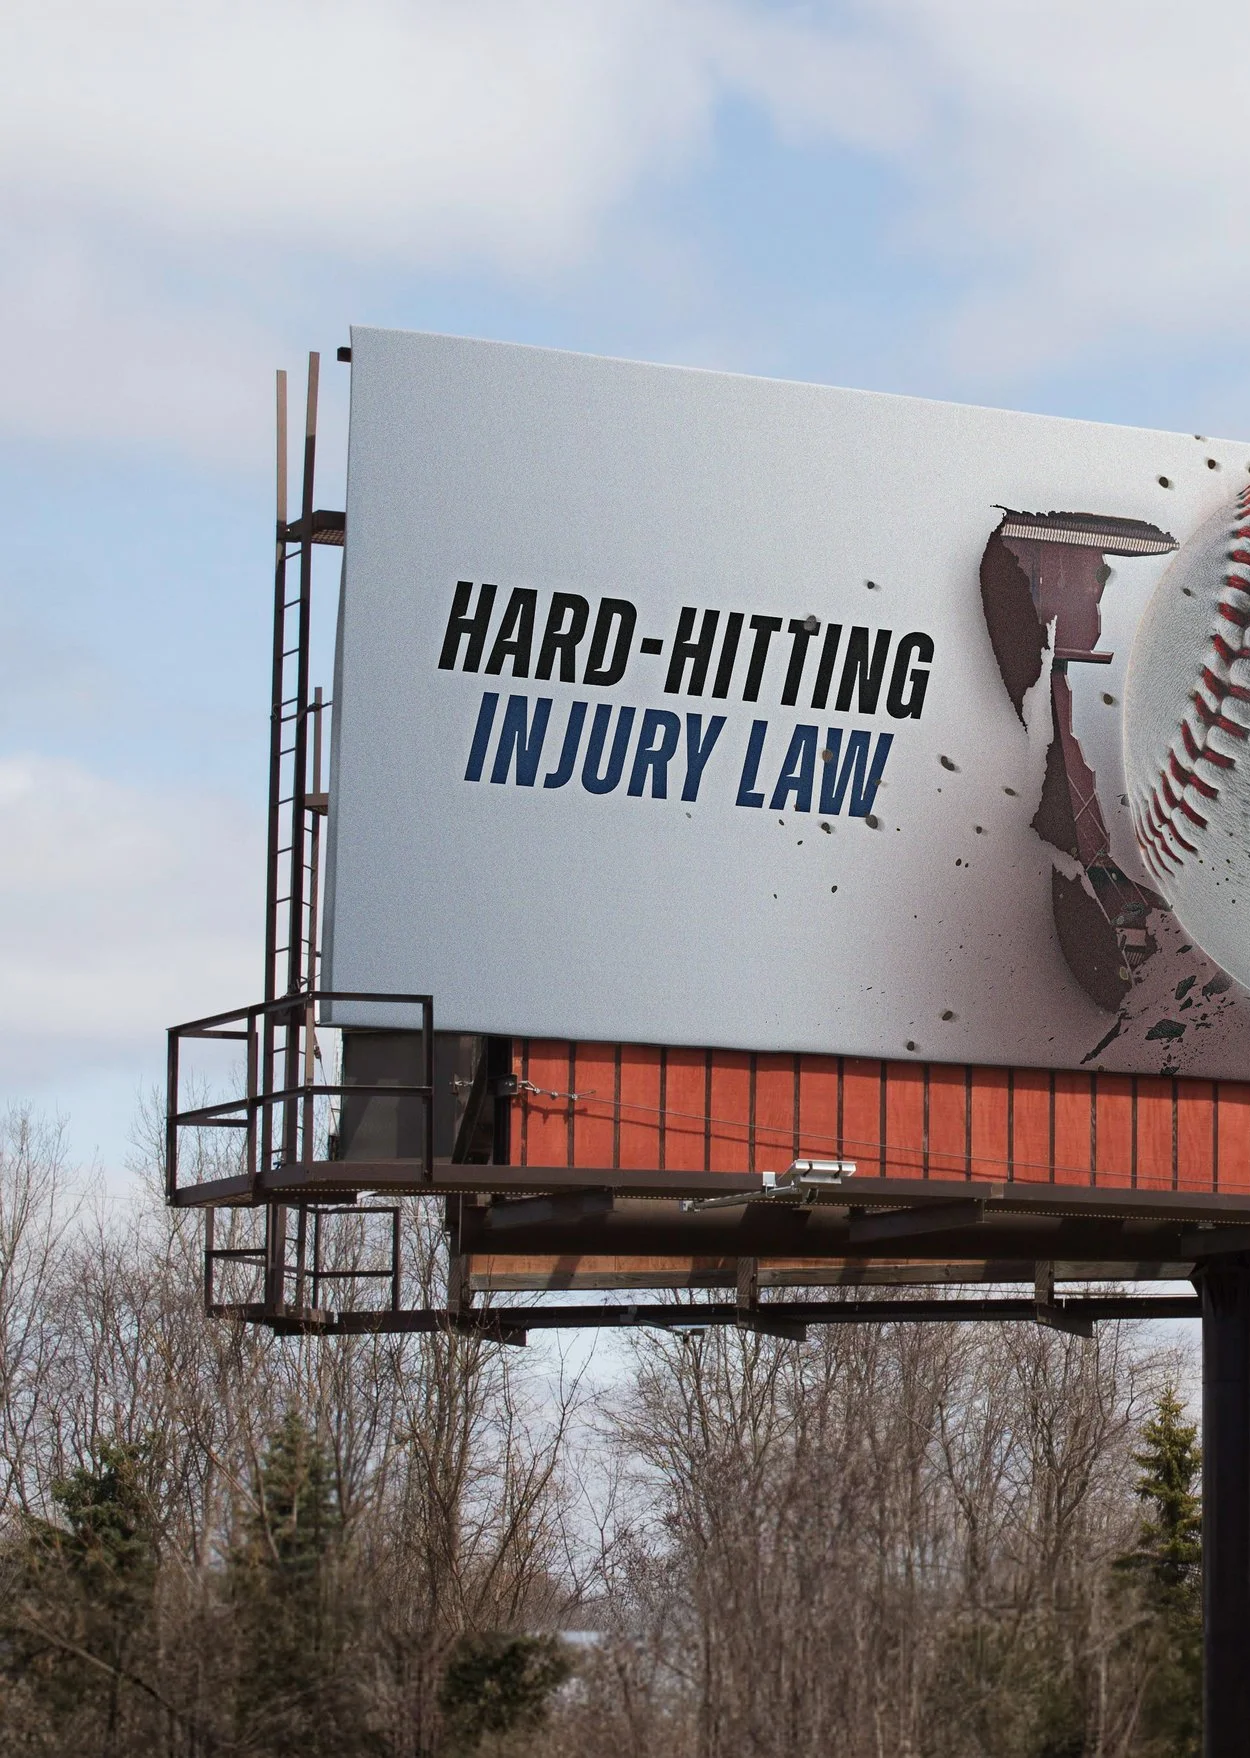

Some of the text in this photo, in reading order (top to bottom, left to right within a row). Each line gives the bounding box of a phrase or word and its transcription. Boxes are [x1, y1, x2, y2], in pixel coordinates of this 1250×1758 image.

[437, 581, 935, 720] HARD-HITTING
[463, 692, 895, 818] INJURY LAW
